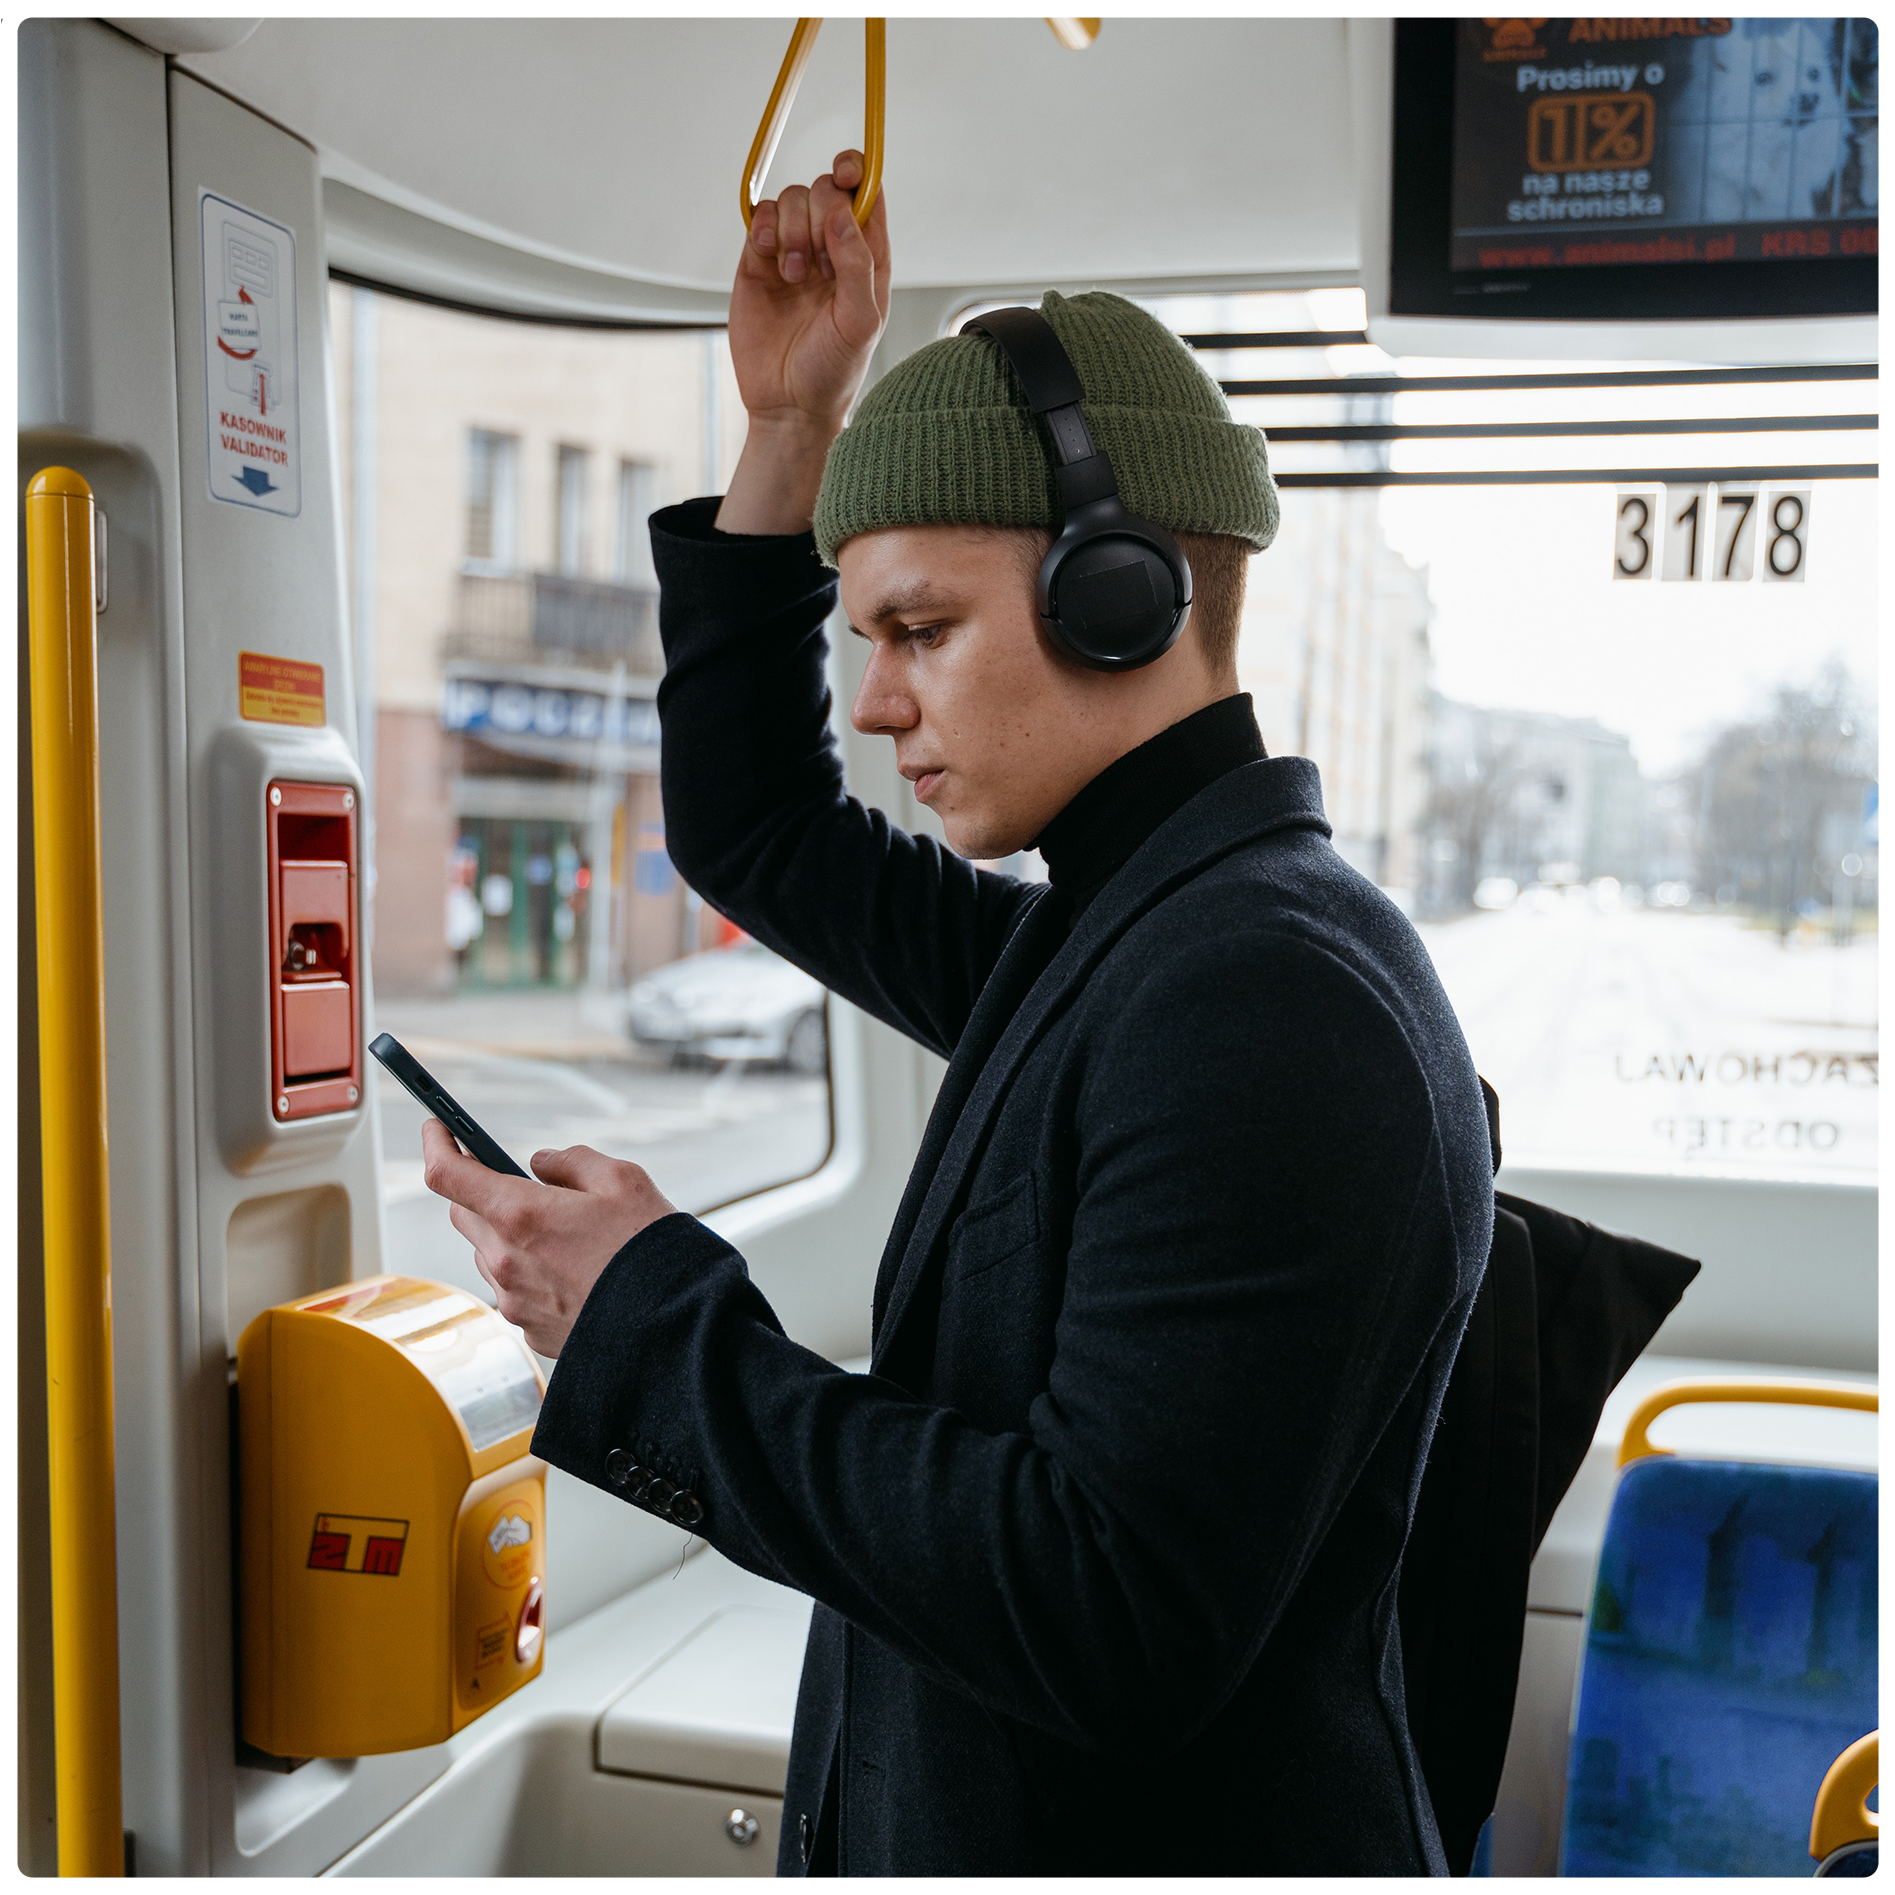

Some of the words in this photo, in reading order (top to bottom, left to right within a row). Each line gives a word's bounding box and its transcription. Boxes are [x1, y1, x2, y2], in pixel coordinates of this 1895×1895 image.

[1516, 58, 1638, 92] Prosimy
[1644, 62, 1666, 85] o
[1543, 103, 1641, 162] 1%
[1522, 173, 1559, 195] na
[1564, 168, 1650, 193] nasze
[1507, 192, 1664, 222] schroniska
[1761, 229, 1831, 257] KRS
[220, 411, 287, 444] KASOWNIK
[220, 434, 288, 467] VALIDATOR
[1617, 495, 1804, 578] 3178
